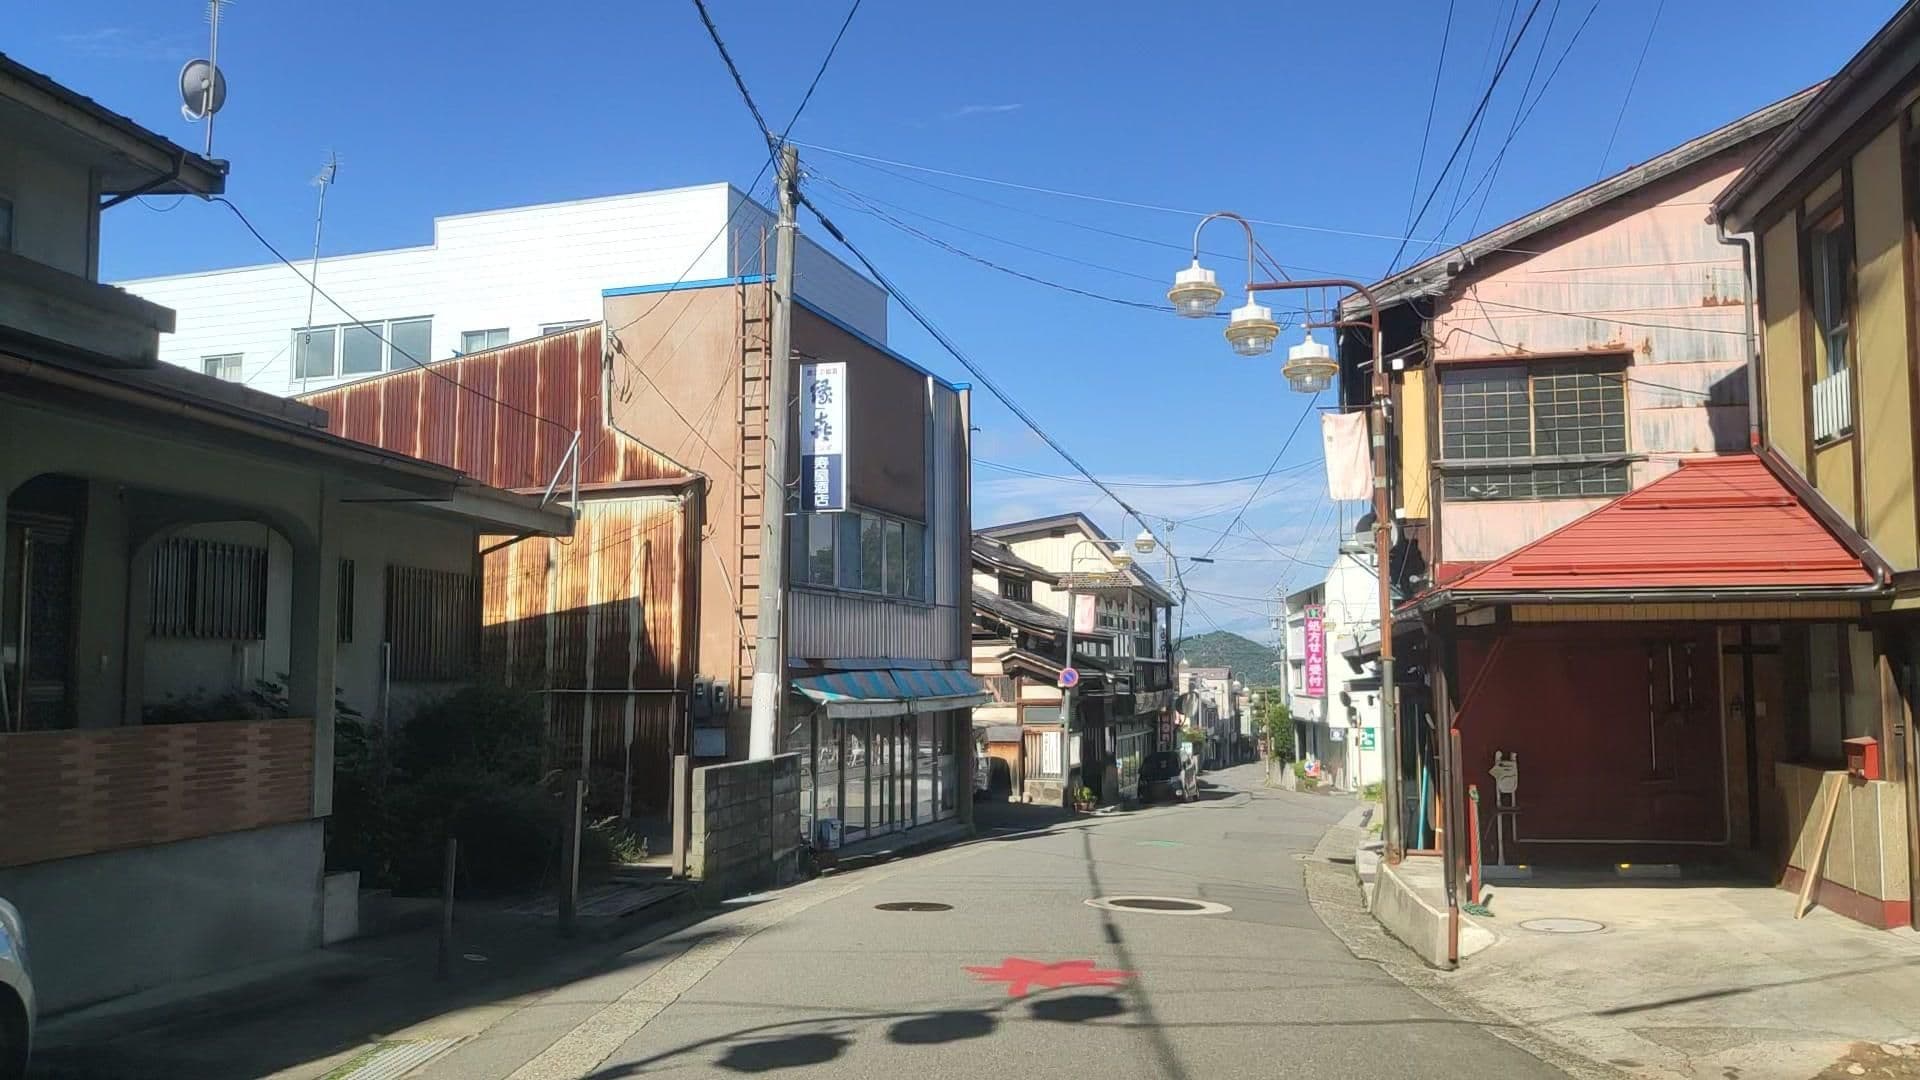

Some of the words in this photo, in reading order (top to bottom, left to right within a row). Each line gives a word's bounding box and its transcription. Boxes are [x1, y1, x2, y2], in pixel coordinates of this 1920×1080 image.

[1307, 620, 1323, 687] 処方せん受付
